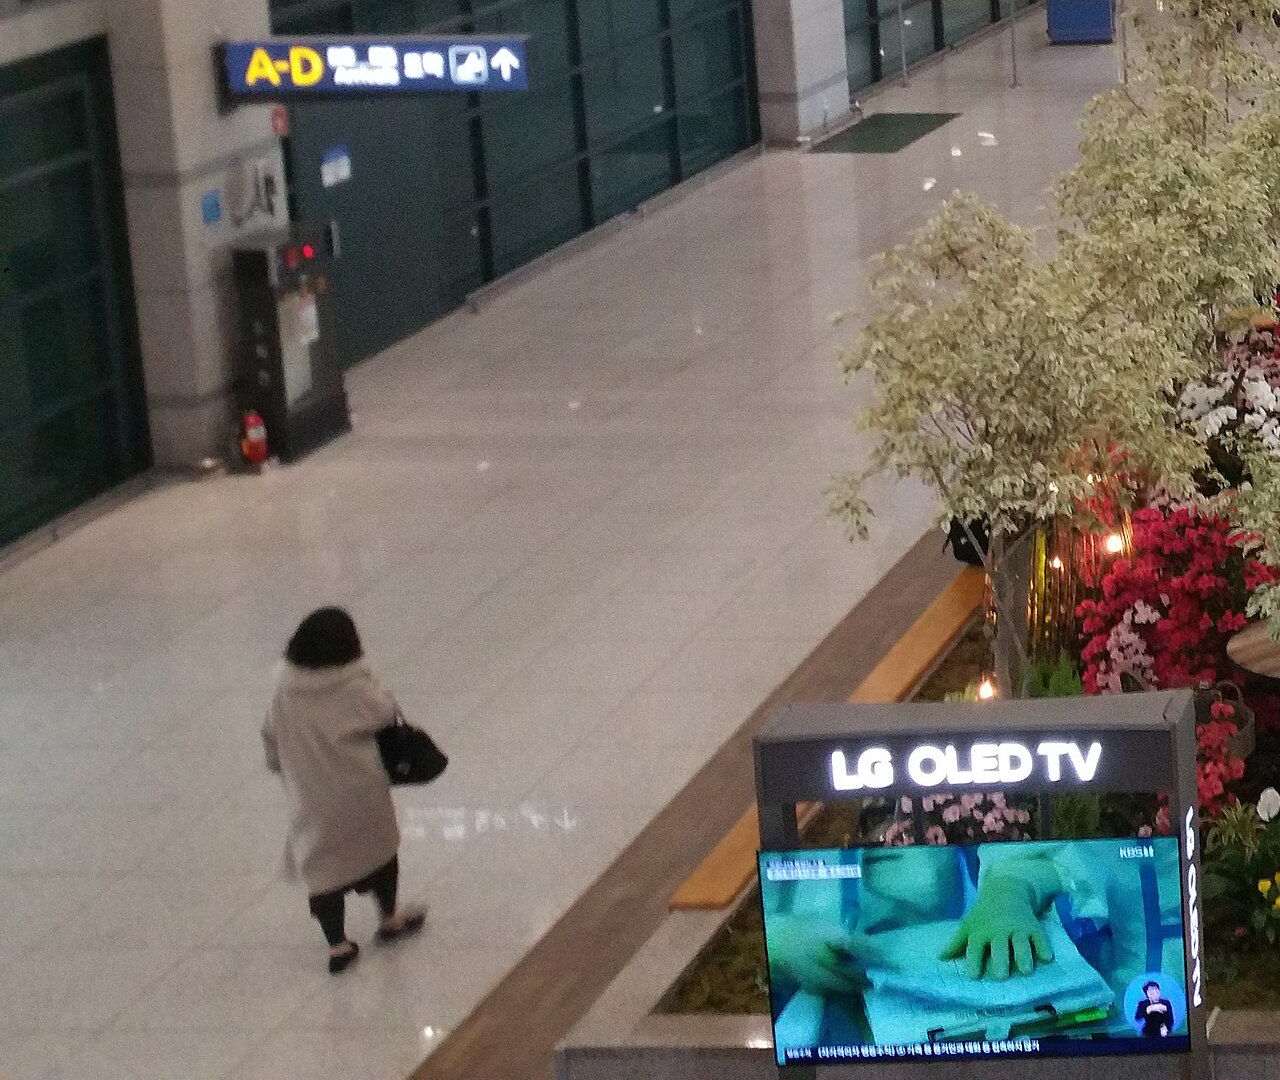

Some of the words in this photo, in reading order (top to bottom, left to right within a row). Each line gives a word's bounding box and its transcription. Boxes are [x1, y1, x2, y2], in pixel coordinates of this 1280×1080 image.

[245, 46, 325, 88] A-D
[830, 747, 895, 792] LG
[907, 742, 1034, 787] OLED
[1036, 741, 1103, 783] TV
